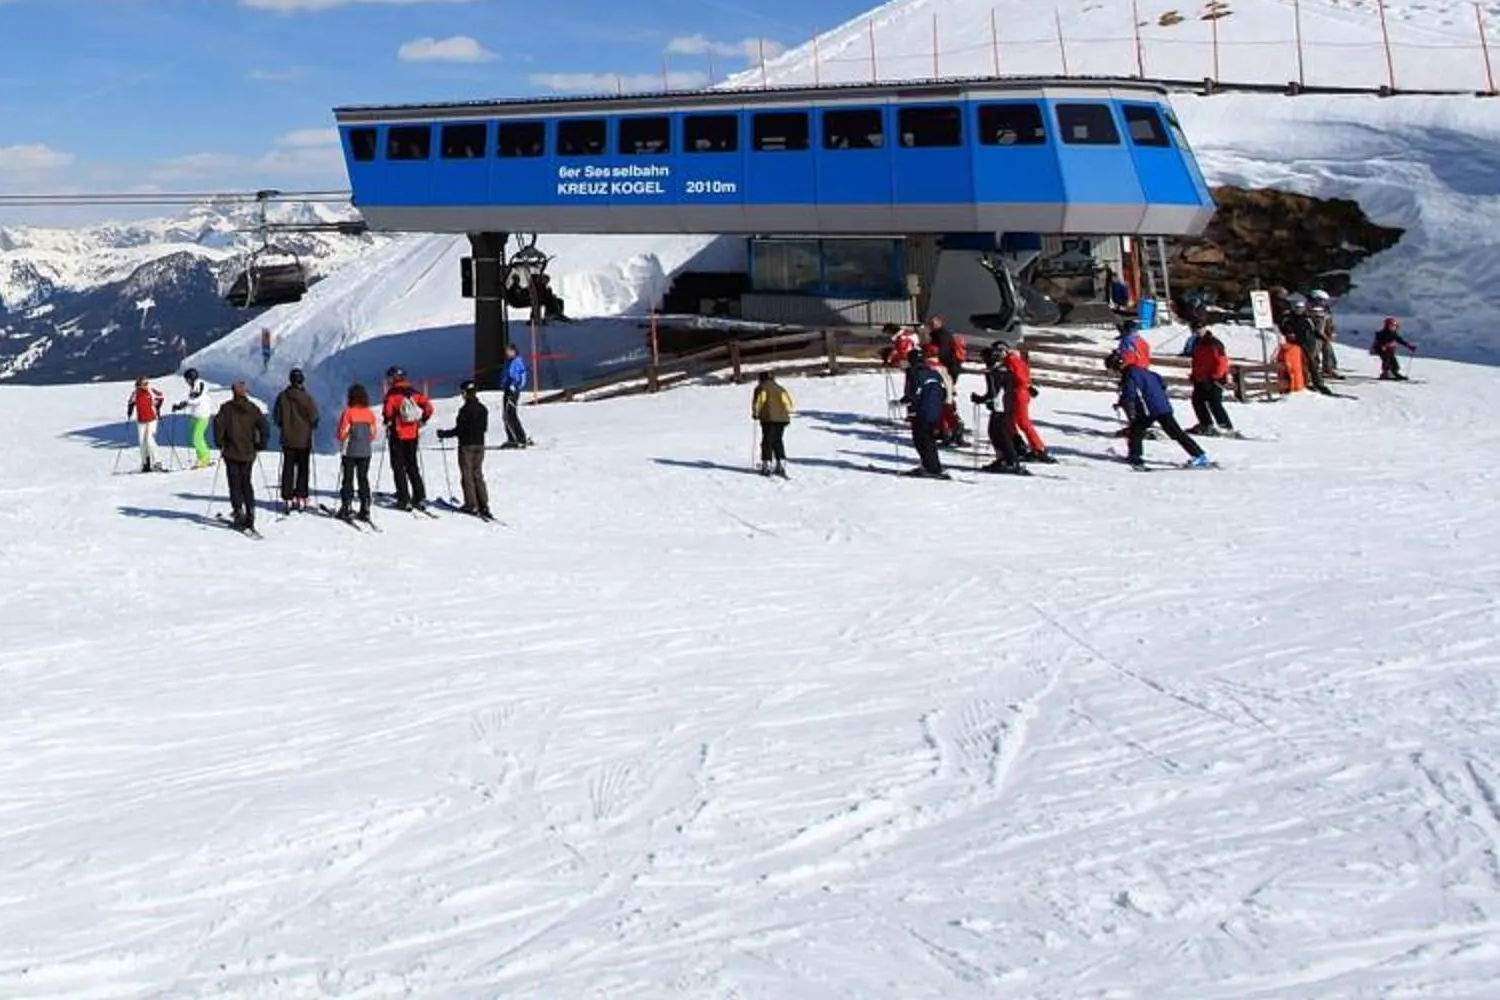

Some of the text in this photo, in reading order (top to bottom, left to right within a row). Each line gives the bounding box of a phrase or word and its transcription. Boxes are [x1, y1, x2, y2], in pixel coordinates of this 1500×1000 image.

[559, 166, 581, 178] 6er
[557, 181, 737, 195] KREUZ KOGEL 2010m
